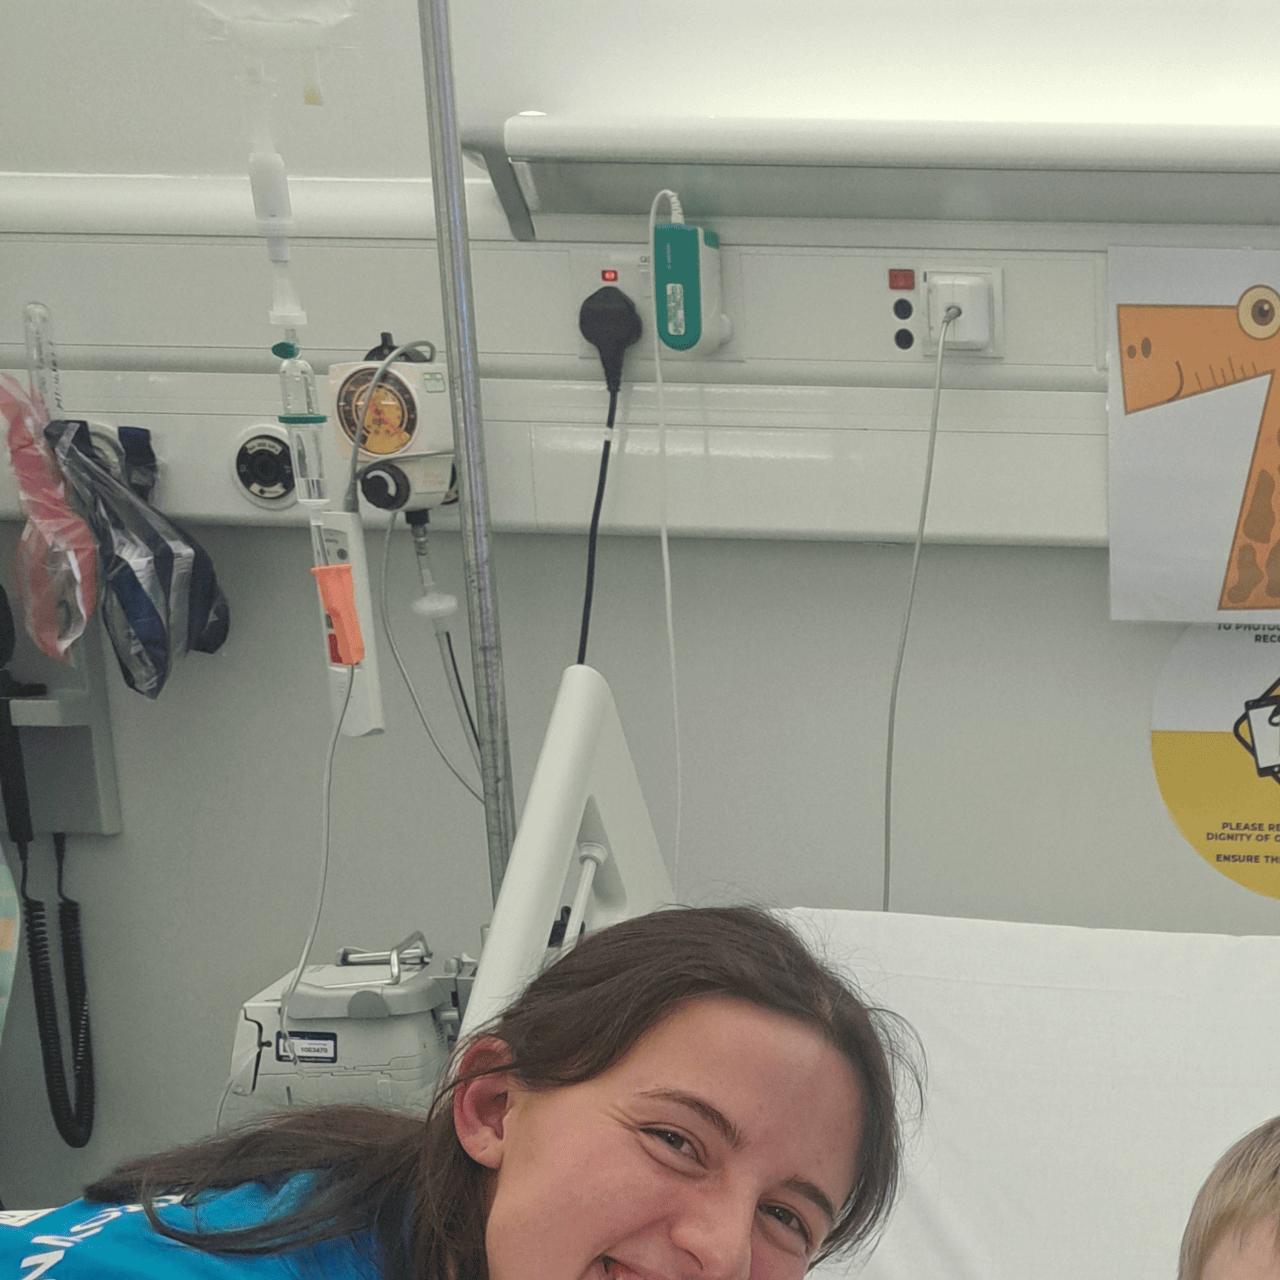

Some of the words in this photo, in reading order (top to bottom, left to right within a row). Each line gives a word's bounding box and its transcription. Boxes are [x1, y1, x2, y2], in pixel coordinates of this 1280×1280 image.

[1222, 822, 1265, 831] PLEASE
[1206, 832, 1252, 842] DIGNITY
[1255, 833, 1271, 842] OF
[1216, 854, 1260, 863] ENSURE
